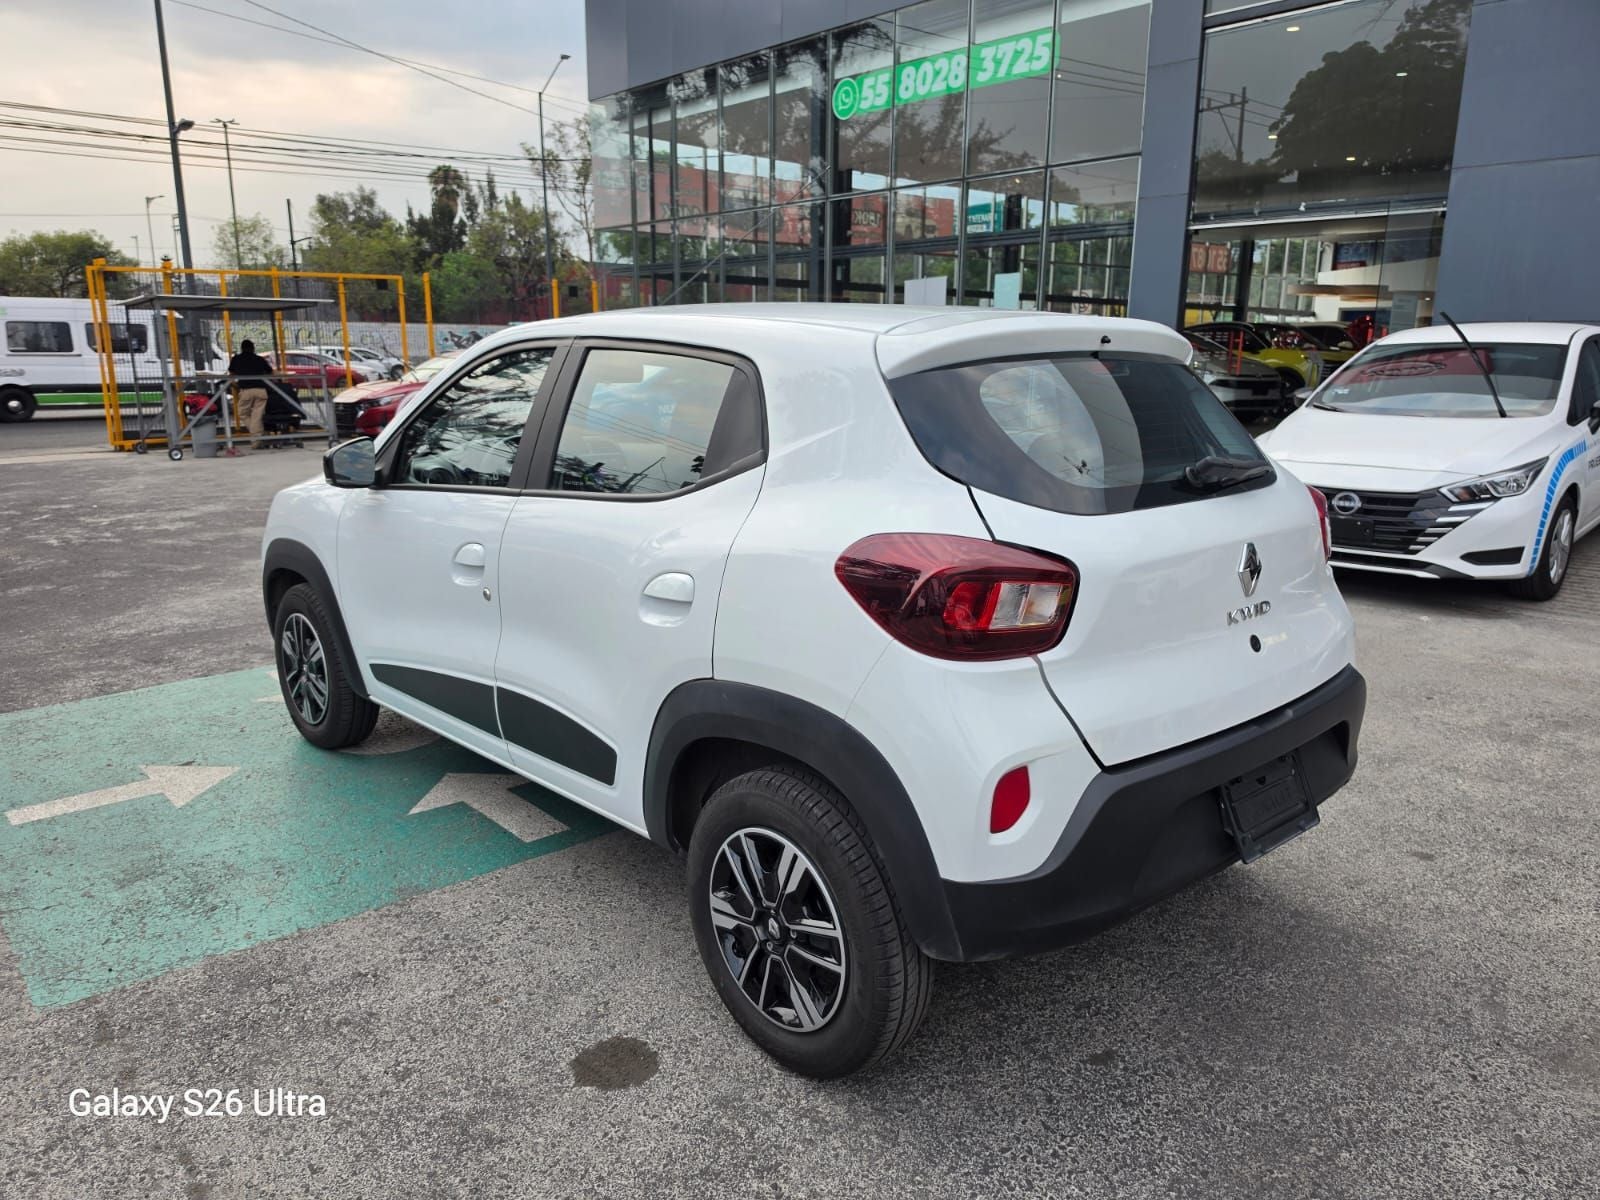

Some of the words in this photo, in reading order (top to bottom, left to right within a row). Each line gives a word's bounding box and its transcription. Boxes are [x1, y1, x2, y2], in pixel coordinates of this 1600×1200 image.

[859, 71, 890, 109] 55
[898, 54, 967, 99] 8028
[976, 32, 1053, 82] 3725
[1226, 600, 1271, 627] KWID
